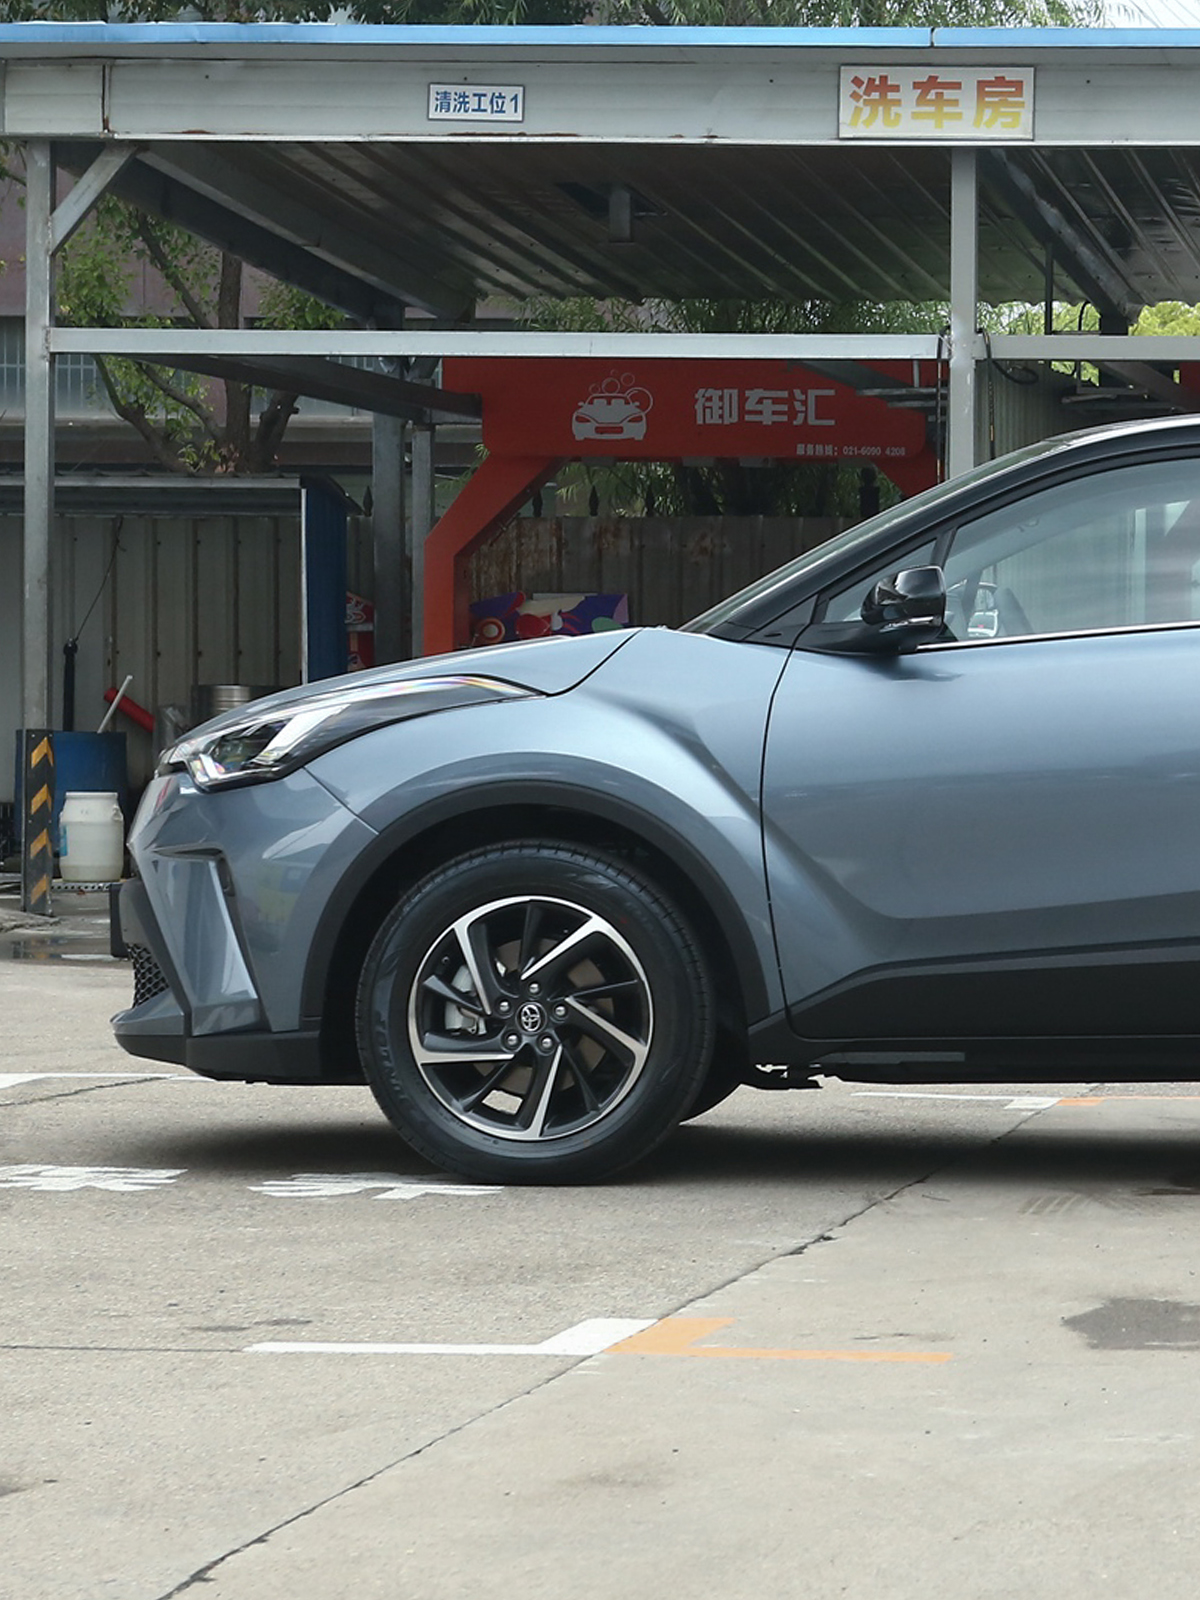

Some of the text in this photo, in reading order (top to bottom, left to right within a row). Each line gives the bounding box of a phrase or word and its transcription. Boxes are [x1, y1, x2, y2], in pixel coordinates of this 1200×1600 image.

[435, 90, 519, 114] 清洗工位1
[849, 75, 1025, 129] 洗车房
[694, 388, 836, 426] 御车汇
